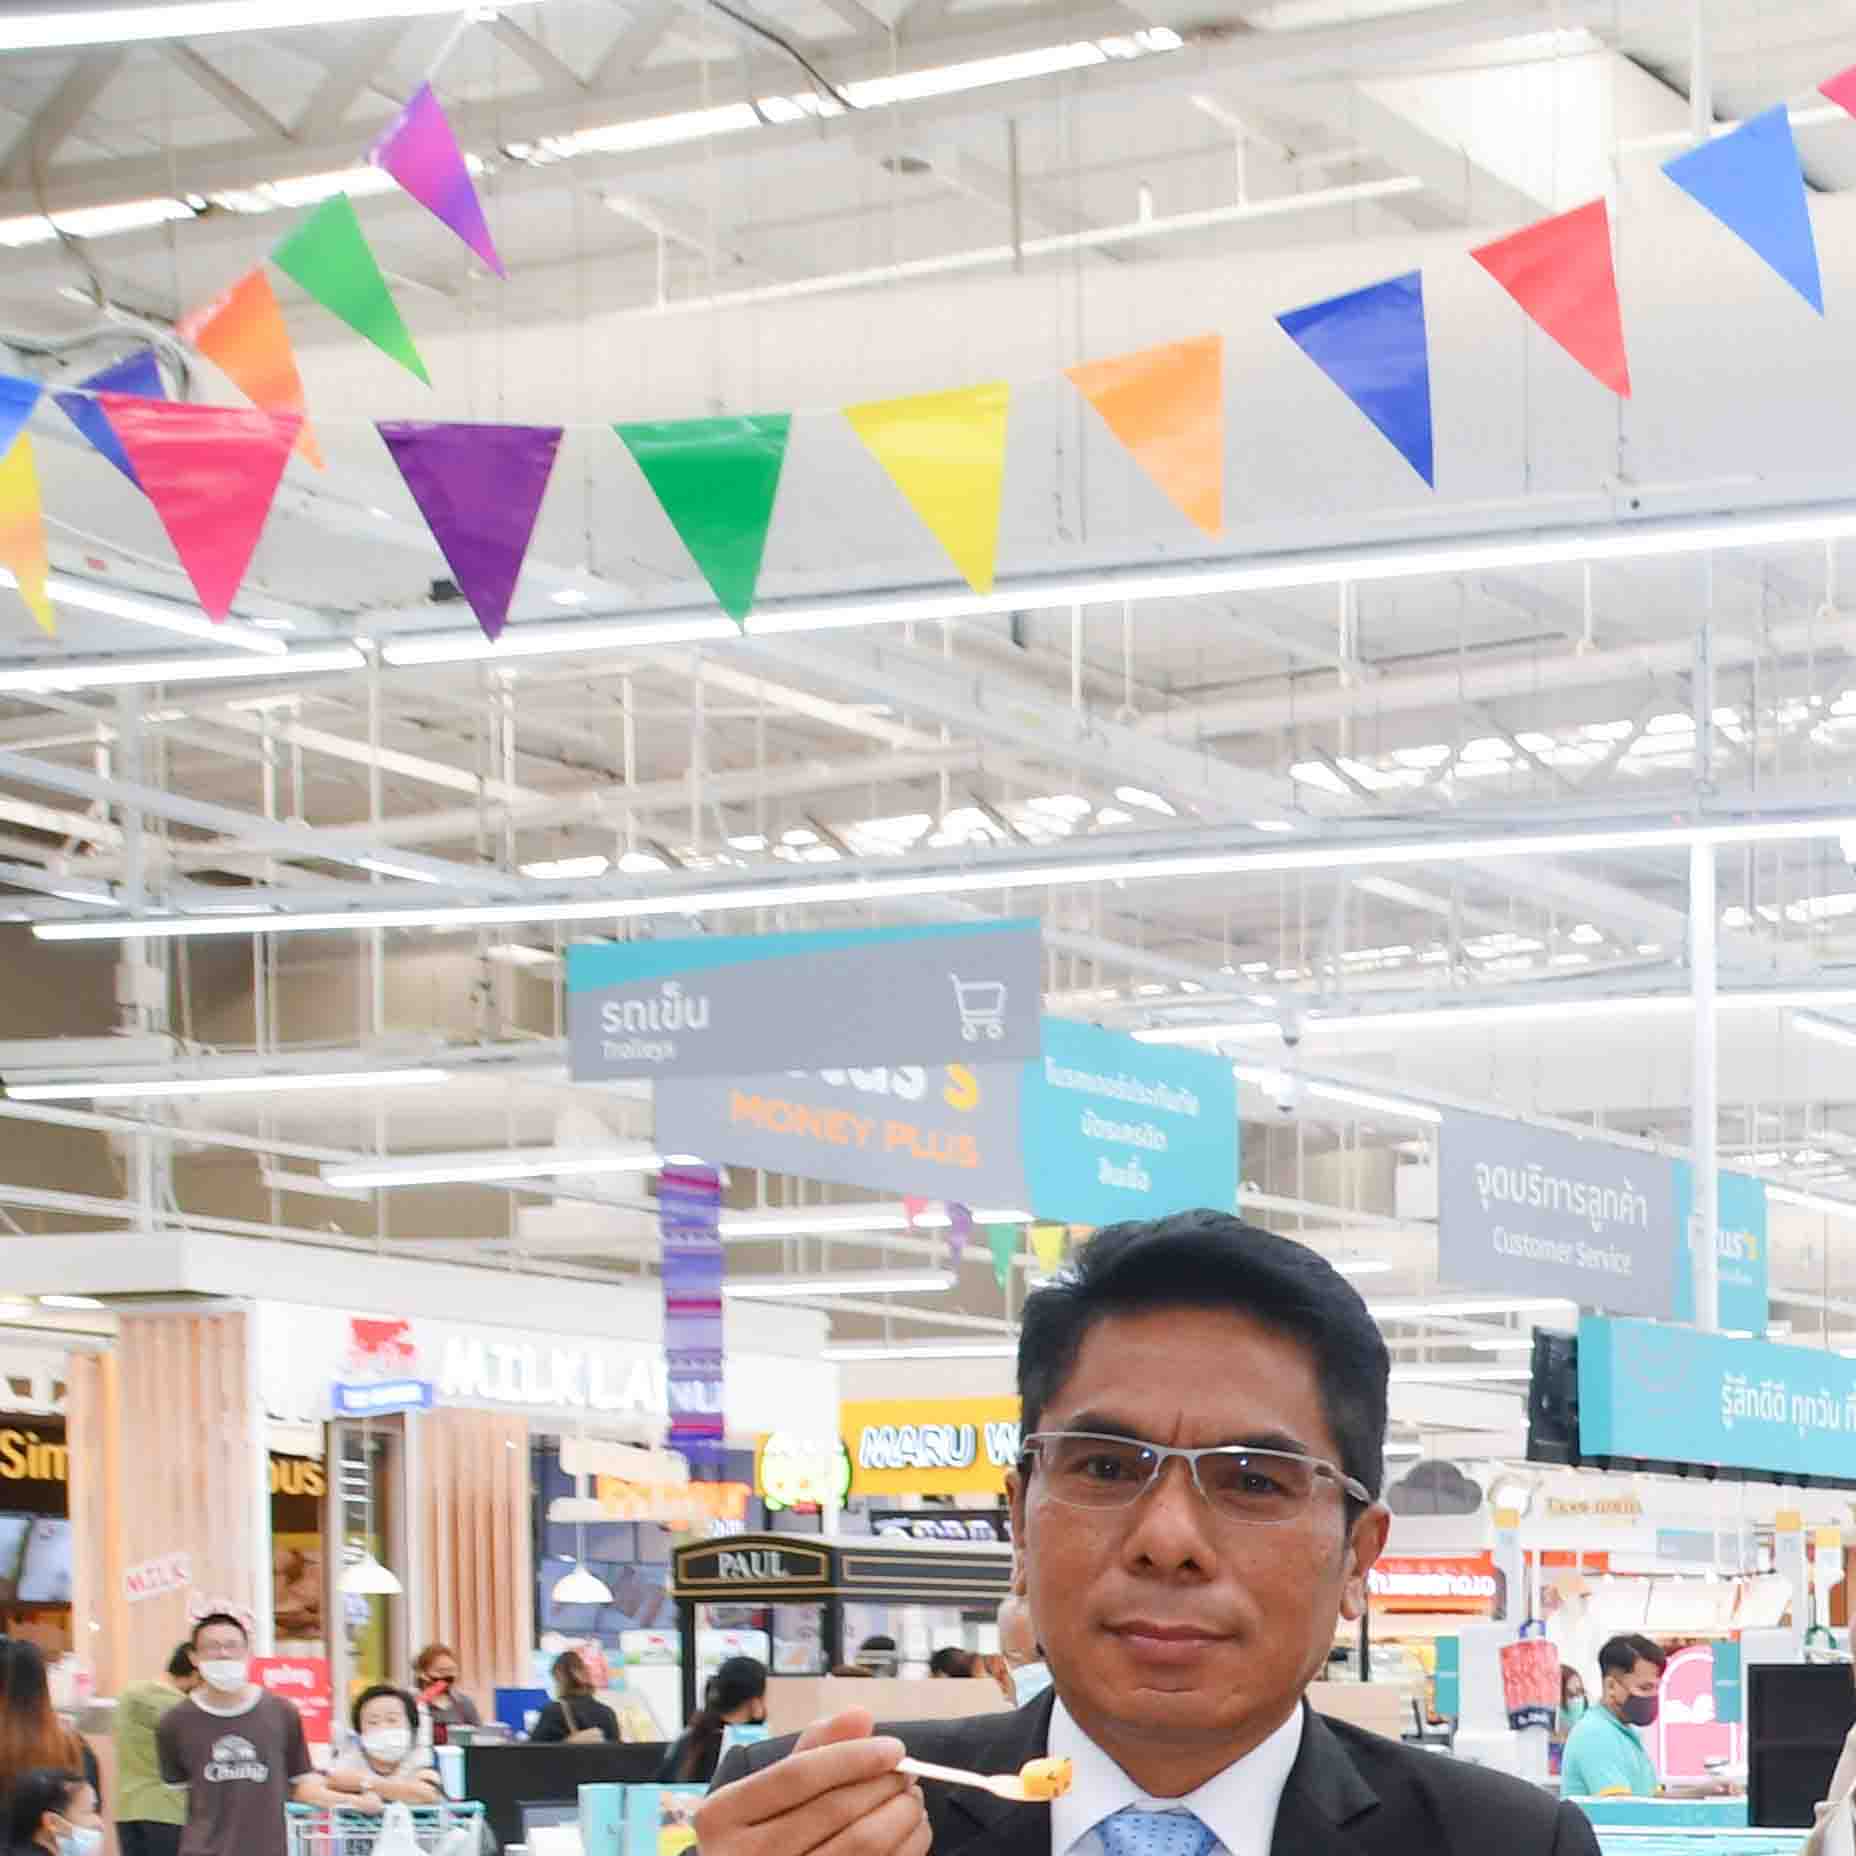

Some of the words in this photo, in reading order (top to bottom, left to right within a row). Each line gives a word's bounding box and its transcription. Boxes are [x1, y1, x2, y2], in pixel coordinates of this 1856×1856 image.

[600, 980, 711, 1032] รถเข็น
[729, 1088, 870, 1151] MONEY
[885, 1119, 980, 1169] PLUS
[1473, 1161, 1649, 1233] จุดบริการลูกค้า
[1490, 1225, 1570, 1264] Customer
[1575, 1244, 1633, 1276] Service
[1721, 1370, 1786, 1430] รู้สึกดีดี
[1791, 1385, 1841, 1437] ทุกวัน
[860, 1425, 977, 1469] MARU
[718, 1550, 789, 1579] PAUL
